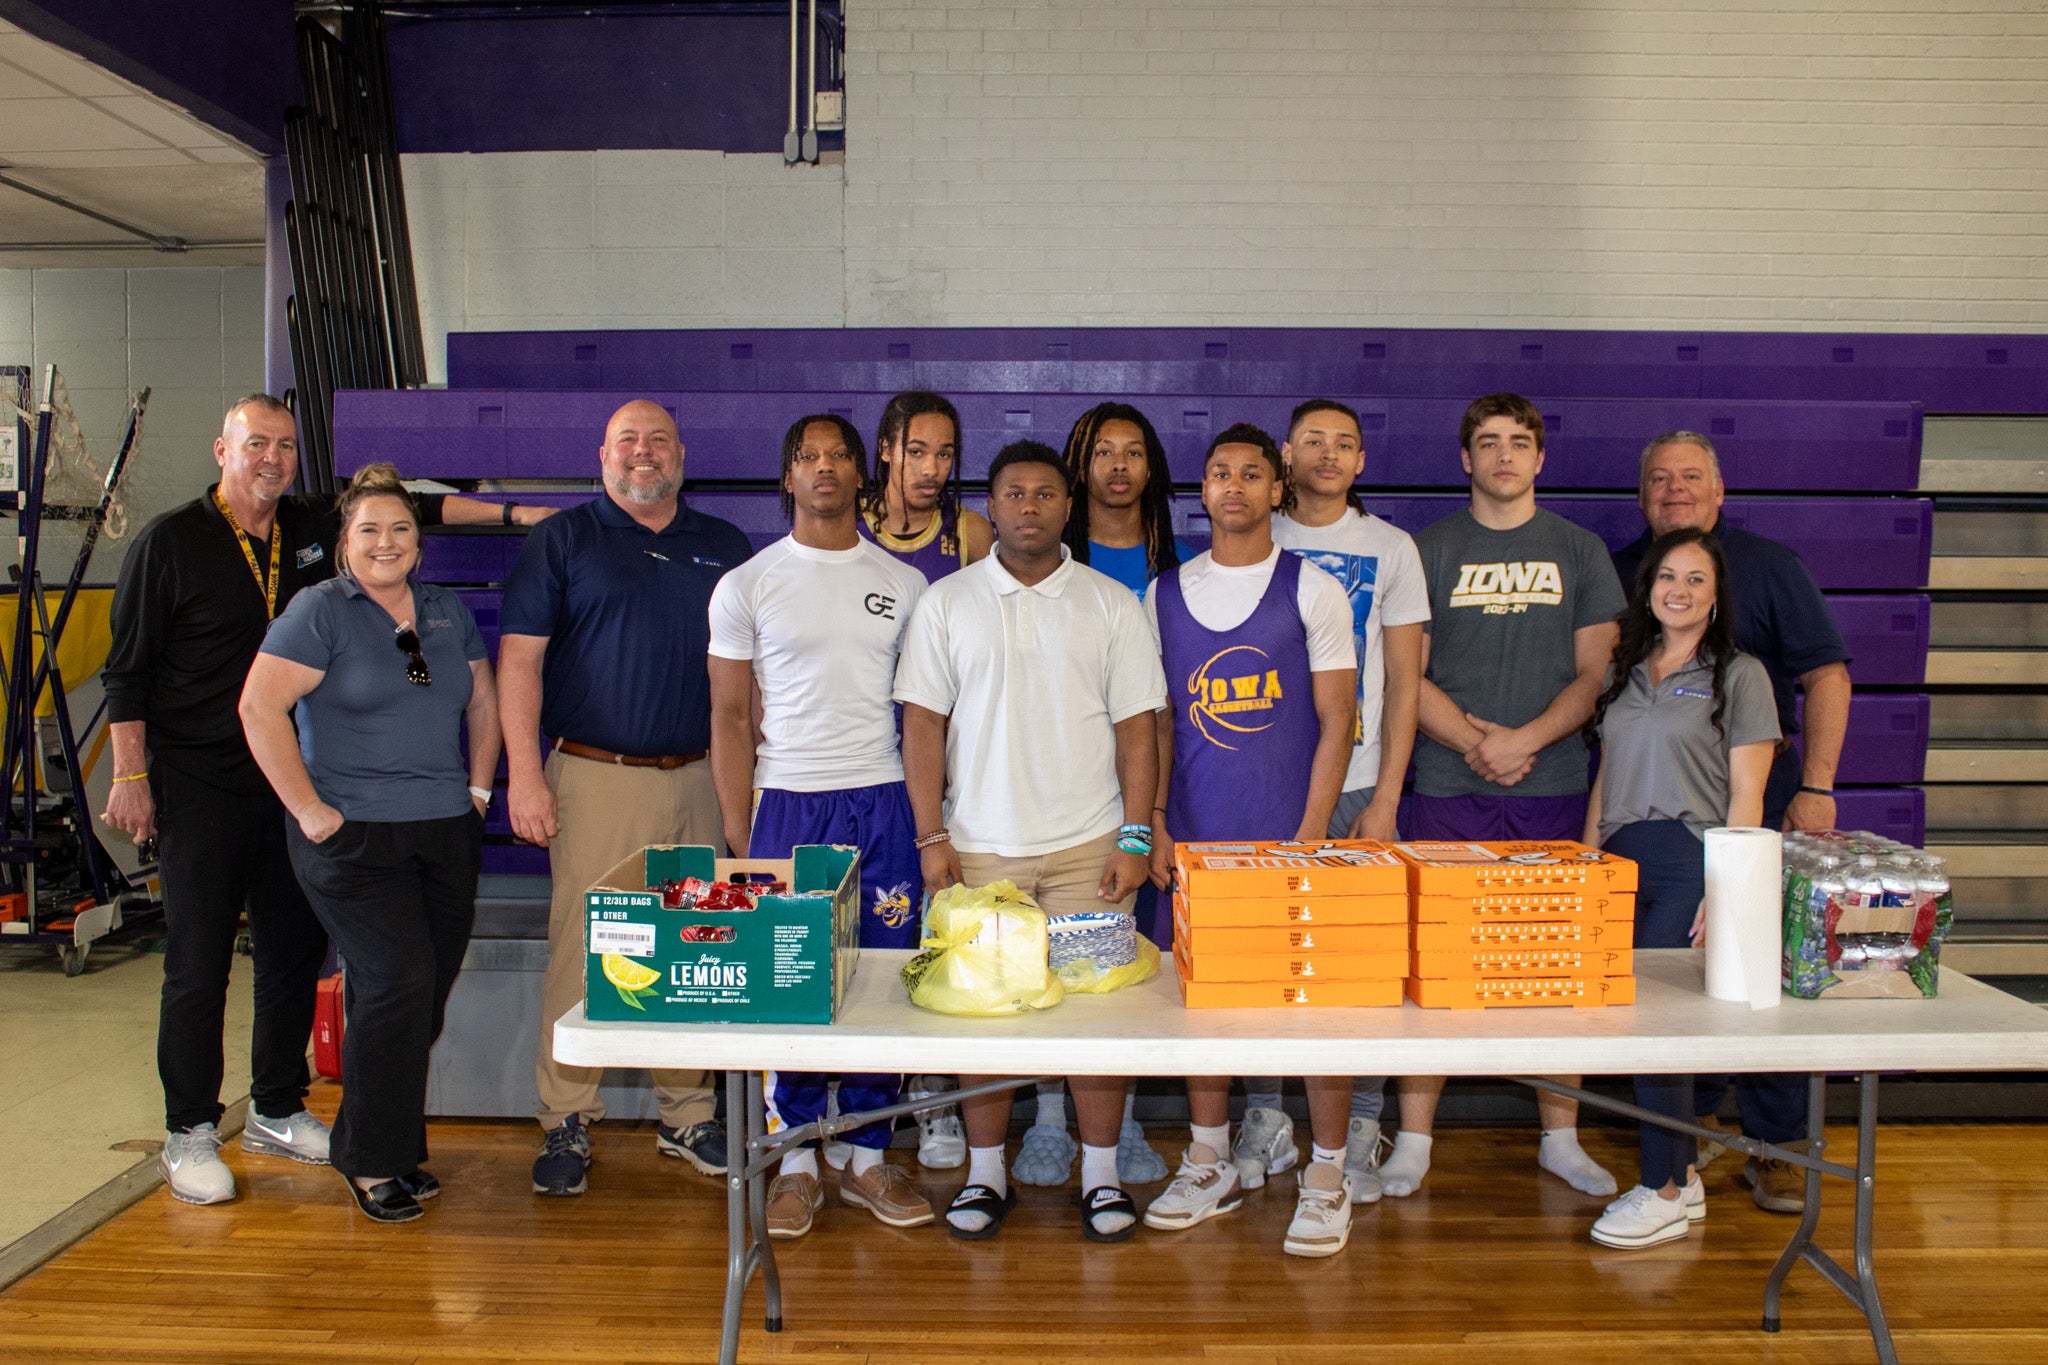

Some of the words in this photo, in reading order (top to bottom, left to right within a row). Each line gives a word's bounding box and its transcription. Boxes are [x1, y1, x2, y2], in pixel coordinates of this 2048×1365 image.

[225, 511, 241, 531] IOWA
[269, 573, 278, 595] IOWA
[1451, 561, 1563, 595] IOWA
[1199, 669, 1283, 706] IOWA
[602, 896, 629, 905] 12/3LB
[630, 897, 652, 906] BAGS
[603, 911, 628, 920] OTHER
[698, 953, 722, 965] Juicy
[670, 964, 748, 987] LEMONS
[958, 1188, 986, 1200] NIKE
[1096, 1190, 1122, 1200] NIKE
